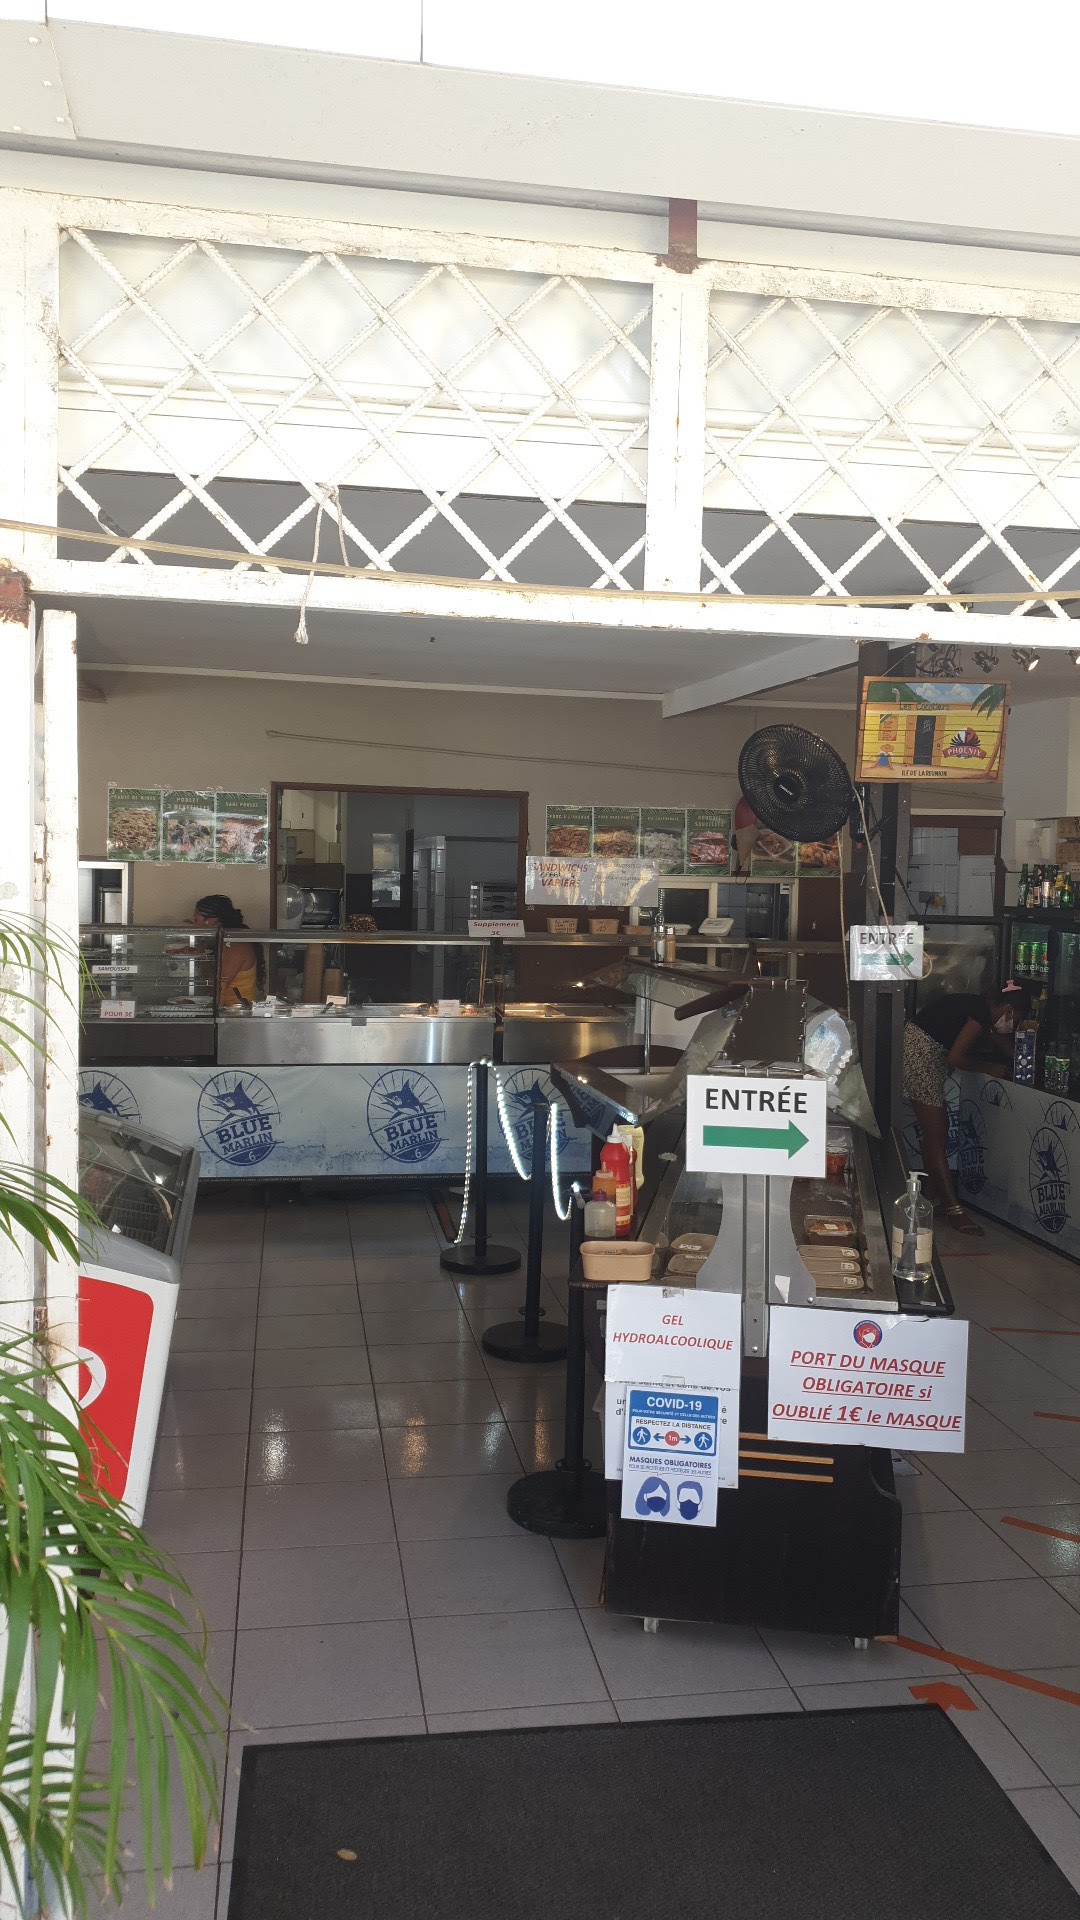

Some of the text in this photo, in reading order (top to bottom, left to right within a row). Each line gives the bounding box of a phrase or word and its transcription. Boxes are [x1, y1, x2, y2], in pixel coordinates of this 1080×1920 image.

[899, 702, 912, 711] Les
[947, 747, 982, 756] PHOENIX
[859, 928, 915, 945] ENTRÉE
[705, 1085, 808, 1114] ENTRÉE
[216, 1115, 273, 1145] BLUE
[383, 1113, 438, 1142] BLUE
[222, 1131, 274, 1156] MARLIN
[390, 1129, 439, 1153] MARLIN
[1037, 1183, 1066, 1204] BLUE
[1038, 1202, 1066, 1217] MARLIN
[661, 1314, 684, 1326] GEL
[612, 1332, 734, 1351] HYDROALCOOLIQUE
[790, 1350, 946, 1376] PORT DU MASQUE
[802, 1376, 933, 1399] OBLIGATOIRE si
[646, 1396, 703, 1411] COVID-19
[635, 1418, 671, 1427] RESPECTEZ
[681, 1422, 712, 1430] DISTANCE
[772, 1403, 963, 1431] OUBLIÉ 1€ le MASQUE
[629, 1456, 712, 1470] MASQUES OBLIGATOIRES
